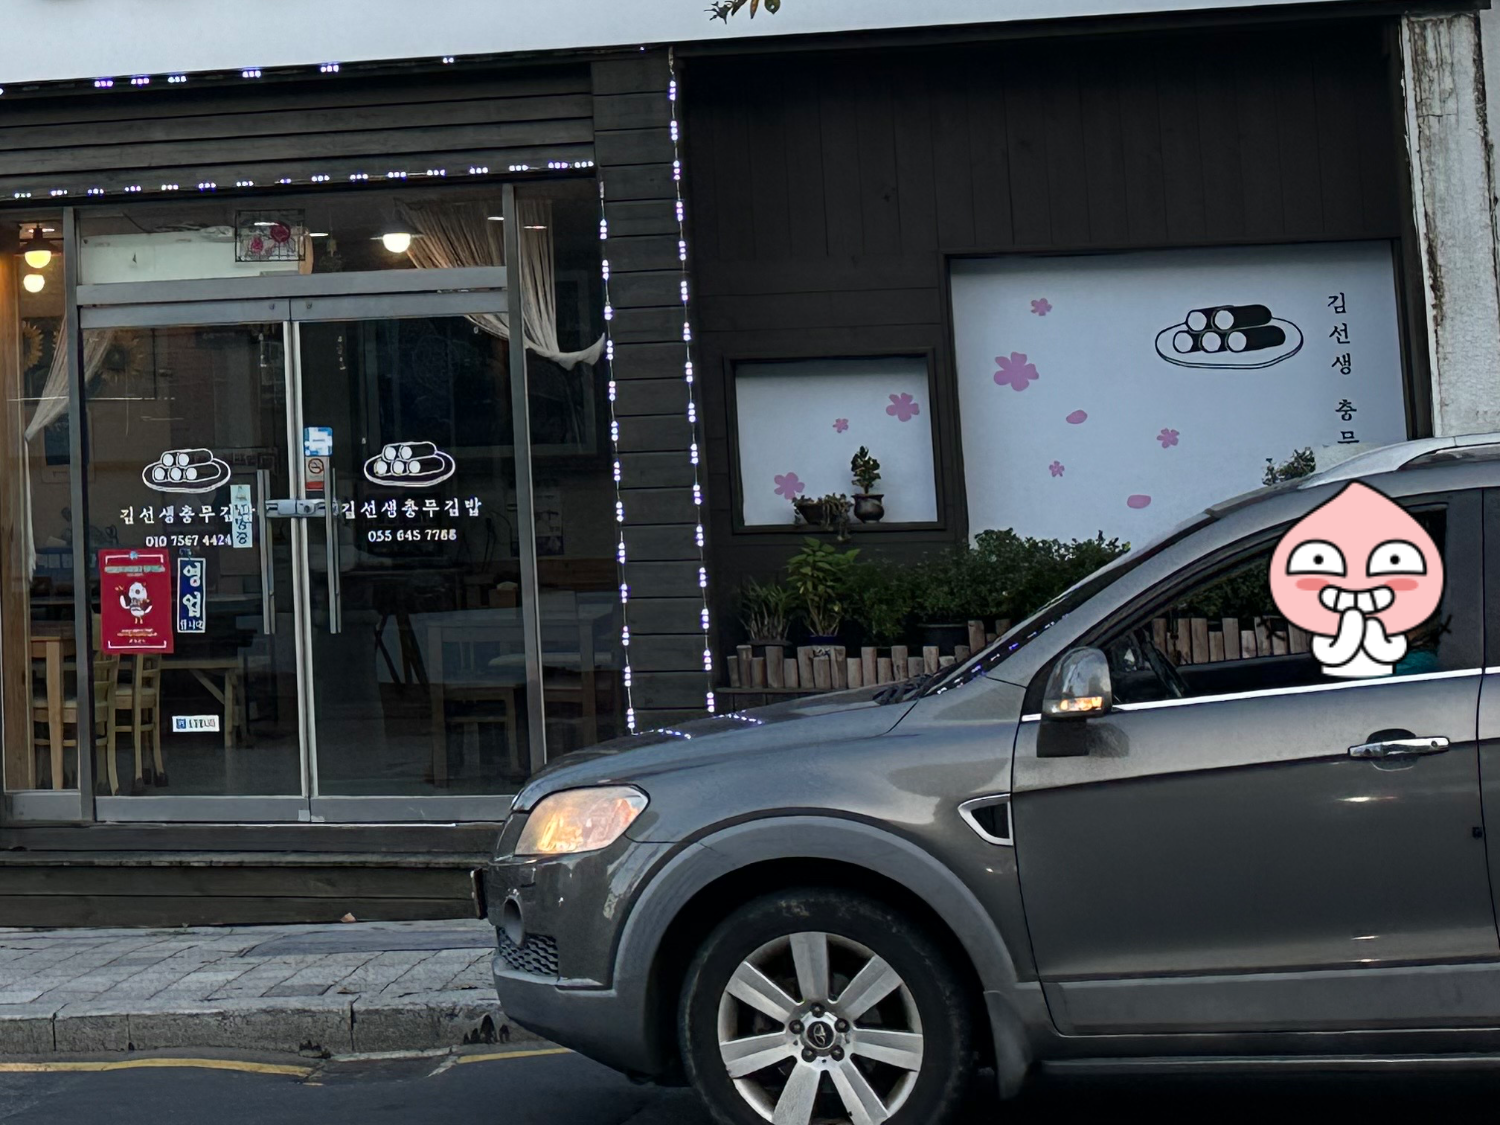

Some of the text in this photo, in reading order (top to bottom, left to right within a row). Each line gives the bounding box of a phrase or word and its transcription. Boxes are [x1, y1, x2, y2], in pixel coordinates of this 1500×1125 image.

[1327, 292, 1352, 375] 김선생
[120, 504, 255, 525] 김선생충무김
[145, 535, 167, 548] 010
[170, 534, 199, 547] 7567
[368, 529, 392, 542] 055
[396, 529, 421, 542] 645
[182, 562, 201, 618] 영업
